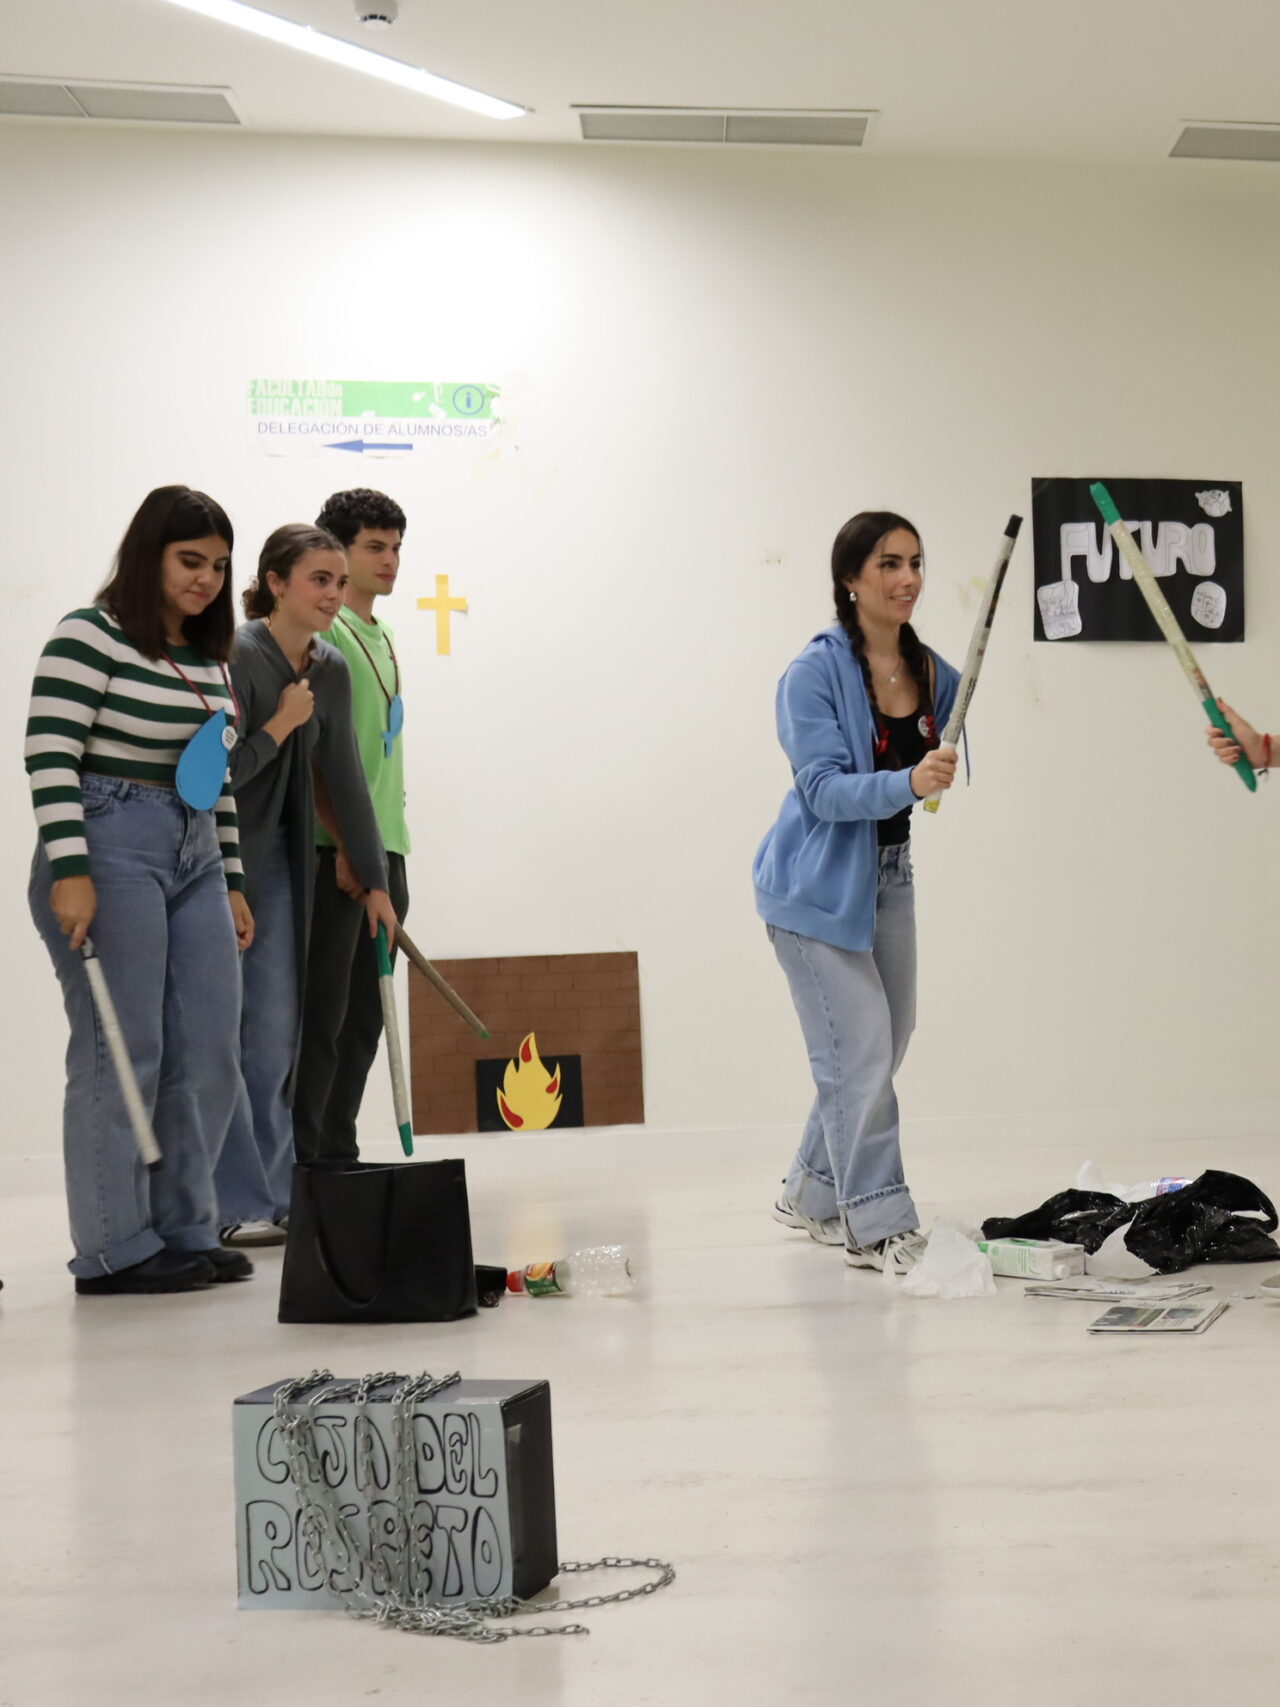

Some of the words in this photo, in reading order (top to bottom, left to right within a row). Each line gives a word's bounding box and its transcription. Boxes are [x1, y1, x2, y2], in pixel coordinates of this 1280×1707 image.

[257, 421, 359, 436] DELEGACIÓN
[363, 423, 384, 436] DE
[387, 423, 488, 438] ALUMNOS/AS
[411, 1412, 498, 1498] DEL
